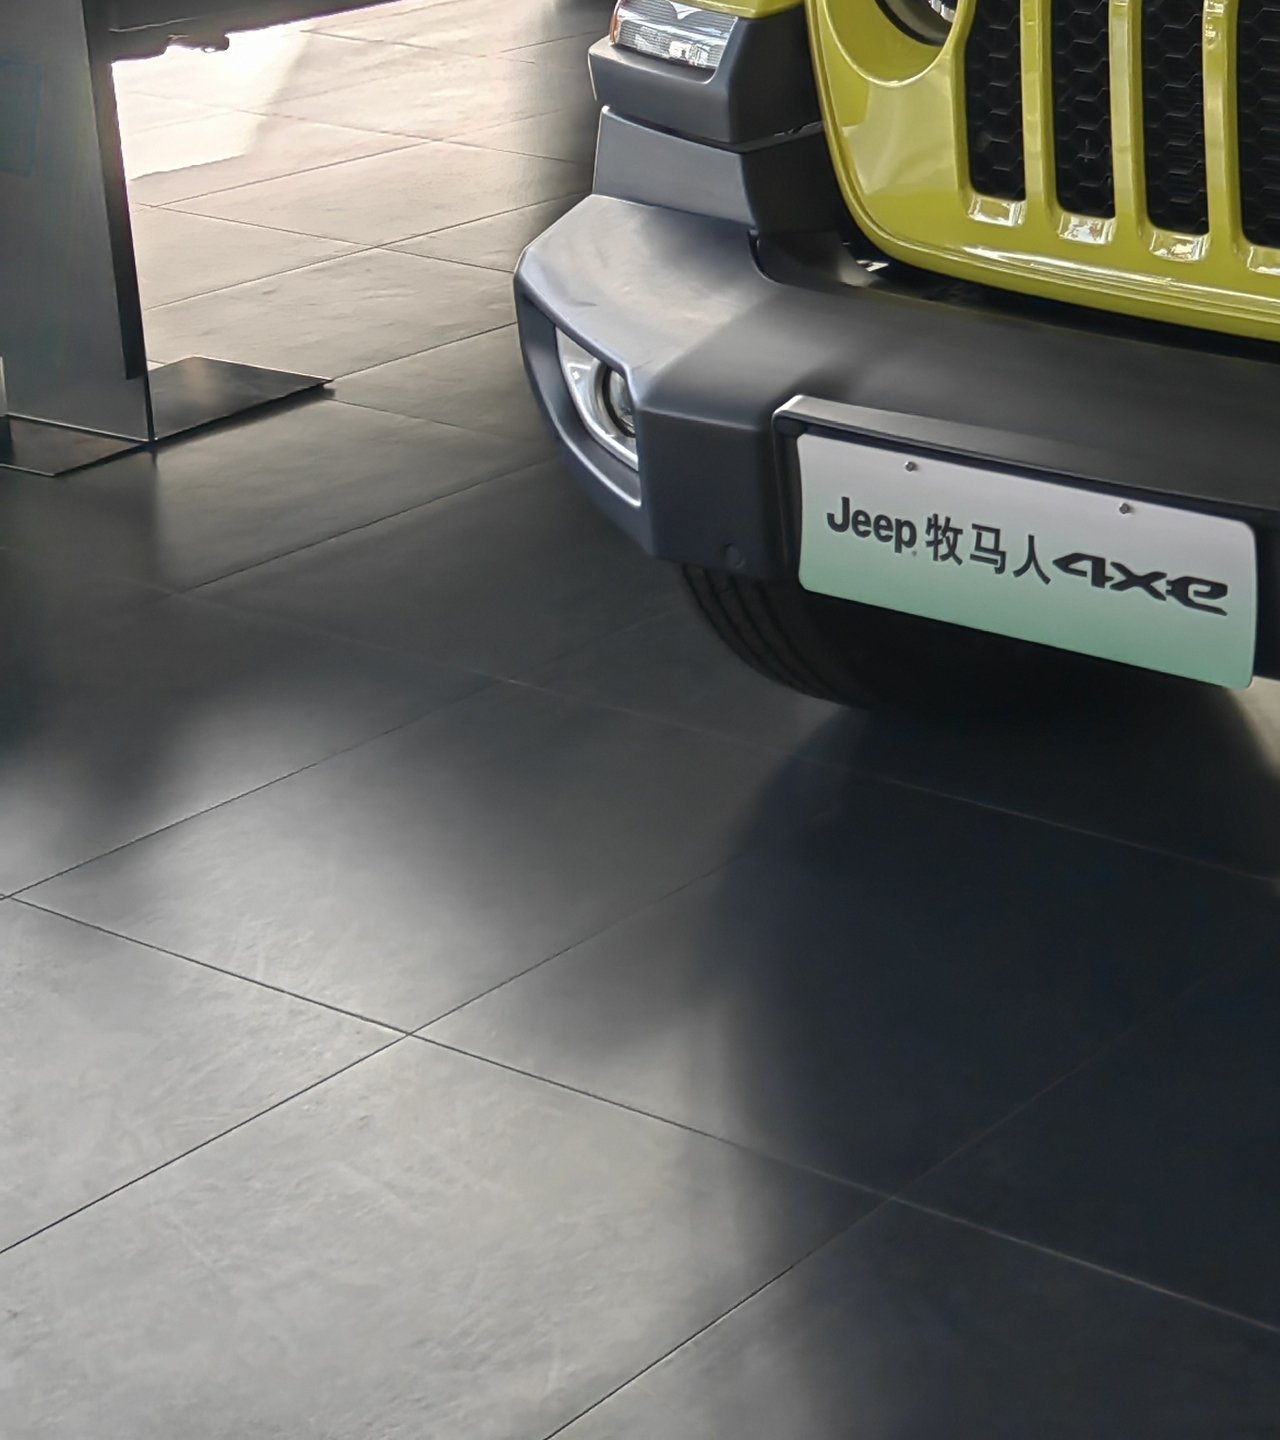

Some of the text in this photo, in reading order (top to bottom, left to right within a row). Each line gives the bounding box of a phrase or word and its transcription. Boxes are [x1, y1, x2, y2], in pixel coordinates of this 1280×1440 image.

[826, 496, 918, 554] Jeep
[925, 513, 1052, 586] 牧马人
